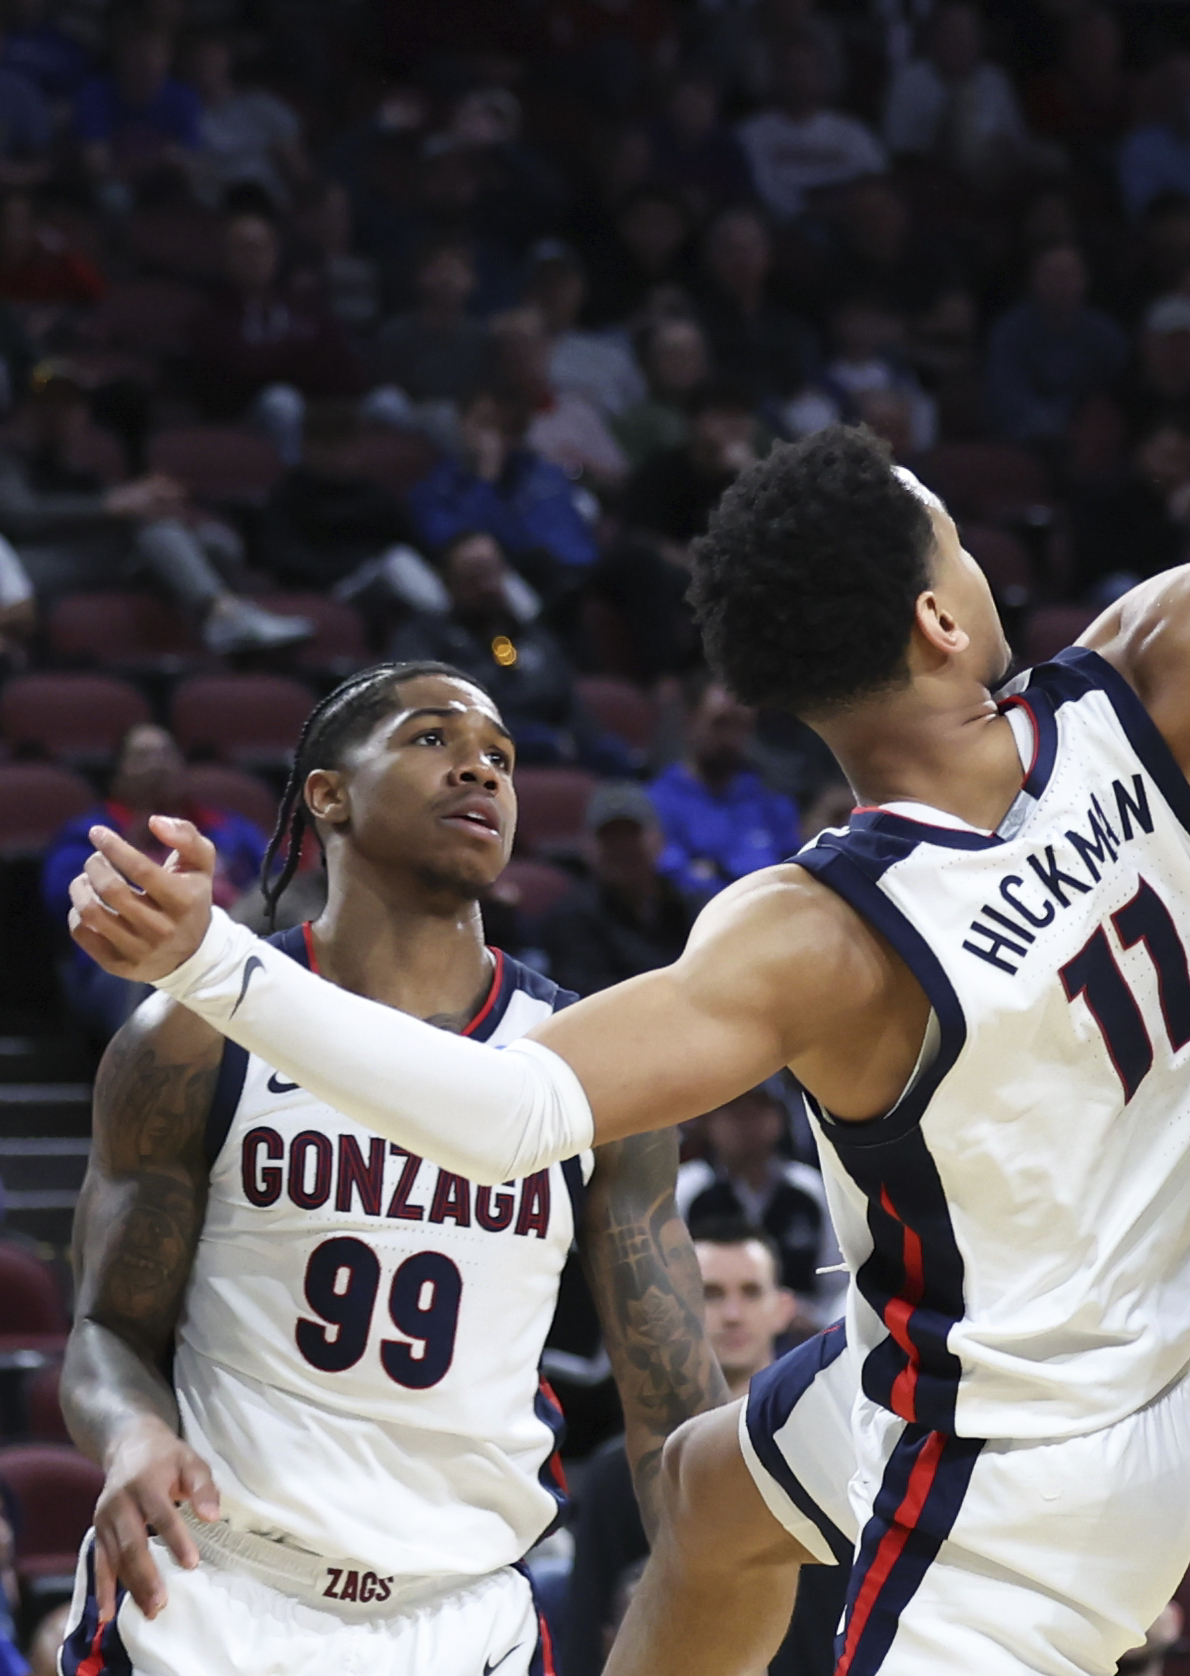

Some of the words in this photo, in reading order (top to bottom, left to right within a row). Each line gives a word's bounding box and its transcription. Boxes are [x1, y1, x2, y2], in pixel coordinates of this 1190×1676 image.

[241, 1126, 551, 1240] GONZAGA
[295, 1235, 463, 1390] 99
[322, 1567, 395, 1603] ZAGS
